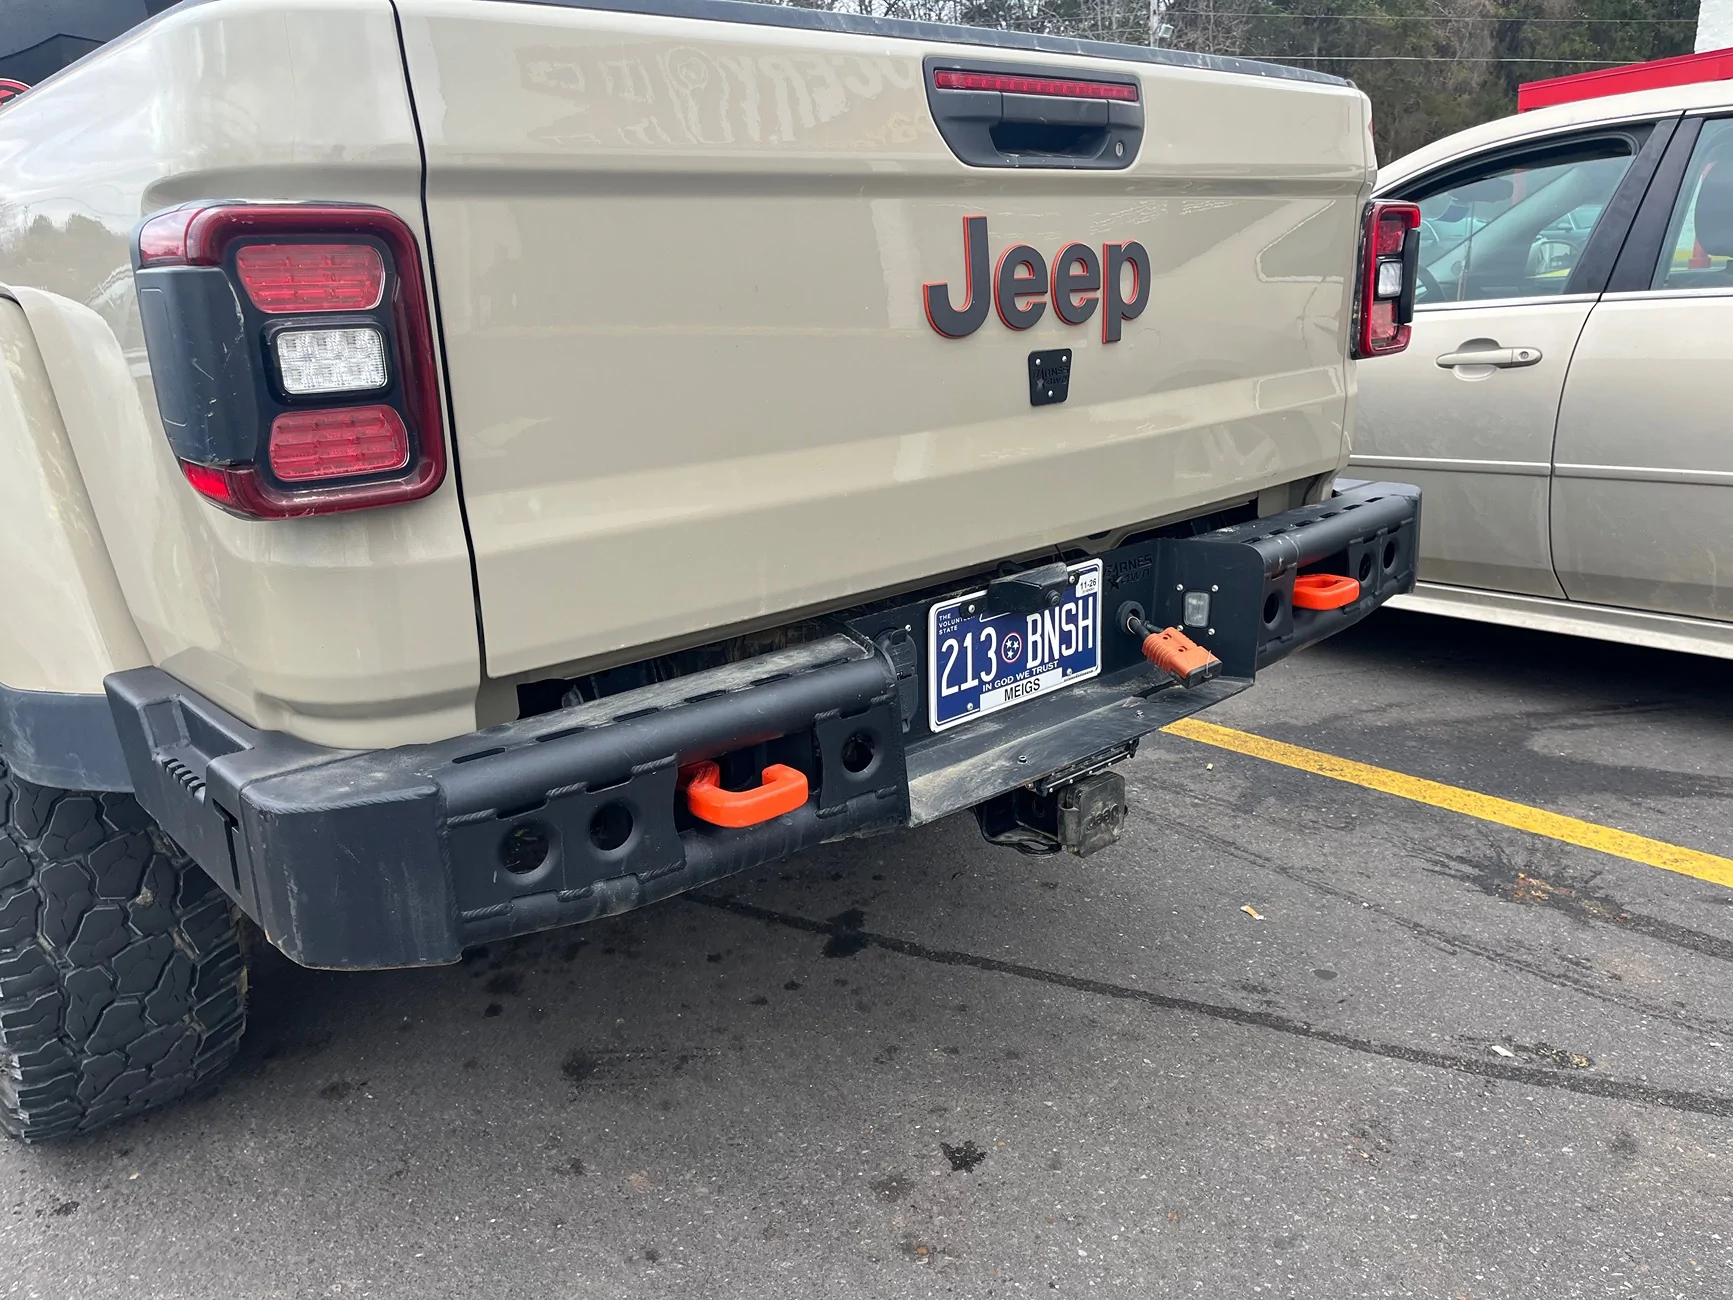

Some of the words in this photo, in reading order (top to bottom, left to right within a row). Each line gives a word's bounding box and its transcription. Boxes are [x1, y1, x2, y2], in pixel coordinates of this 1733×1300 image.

[923, 213, 1151, 344] Jeep
[1080, 578, 1097, 590] 11-26
[938, 613, 952, 621] THE
[938, 624, 958, 635] STATE
[941, 626, 998, 697] 213
[1026, 596, 1093, 669] BNSH
[982, 684, 993, 693] IN
[994, 675, 1014, 688] GOD
[1015, 669, 1030, 681] WE
[1031, 660, 1059, 676] TRUST
[1004, 678, 1041, 701] MEIGS
